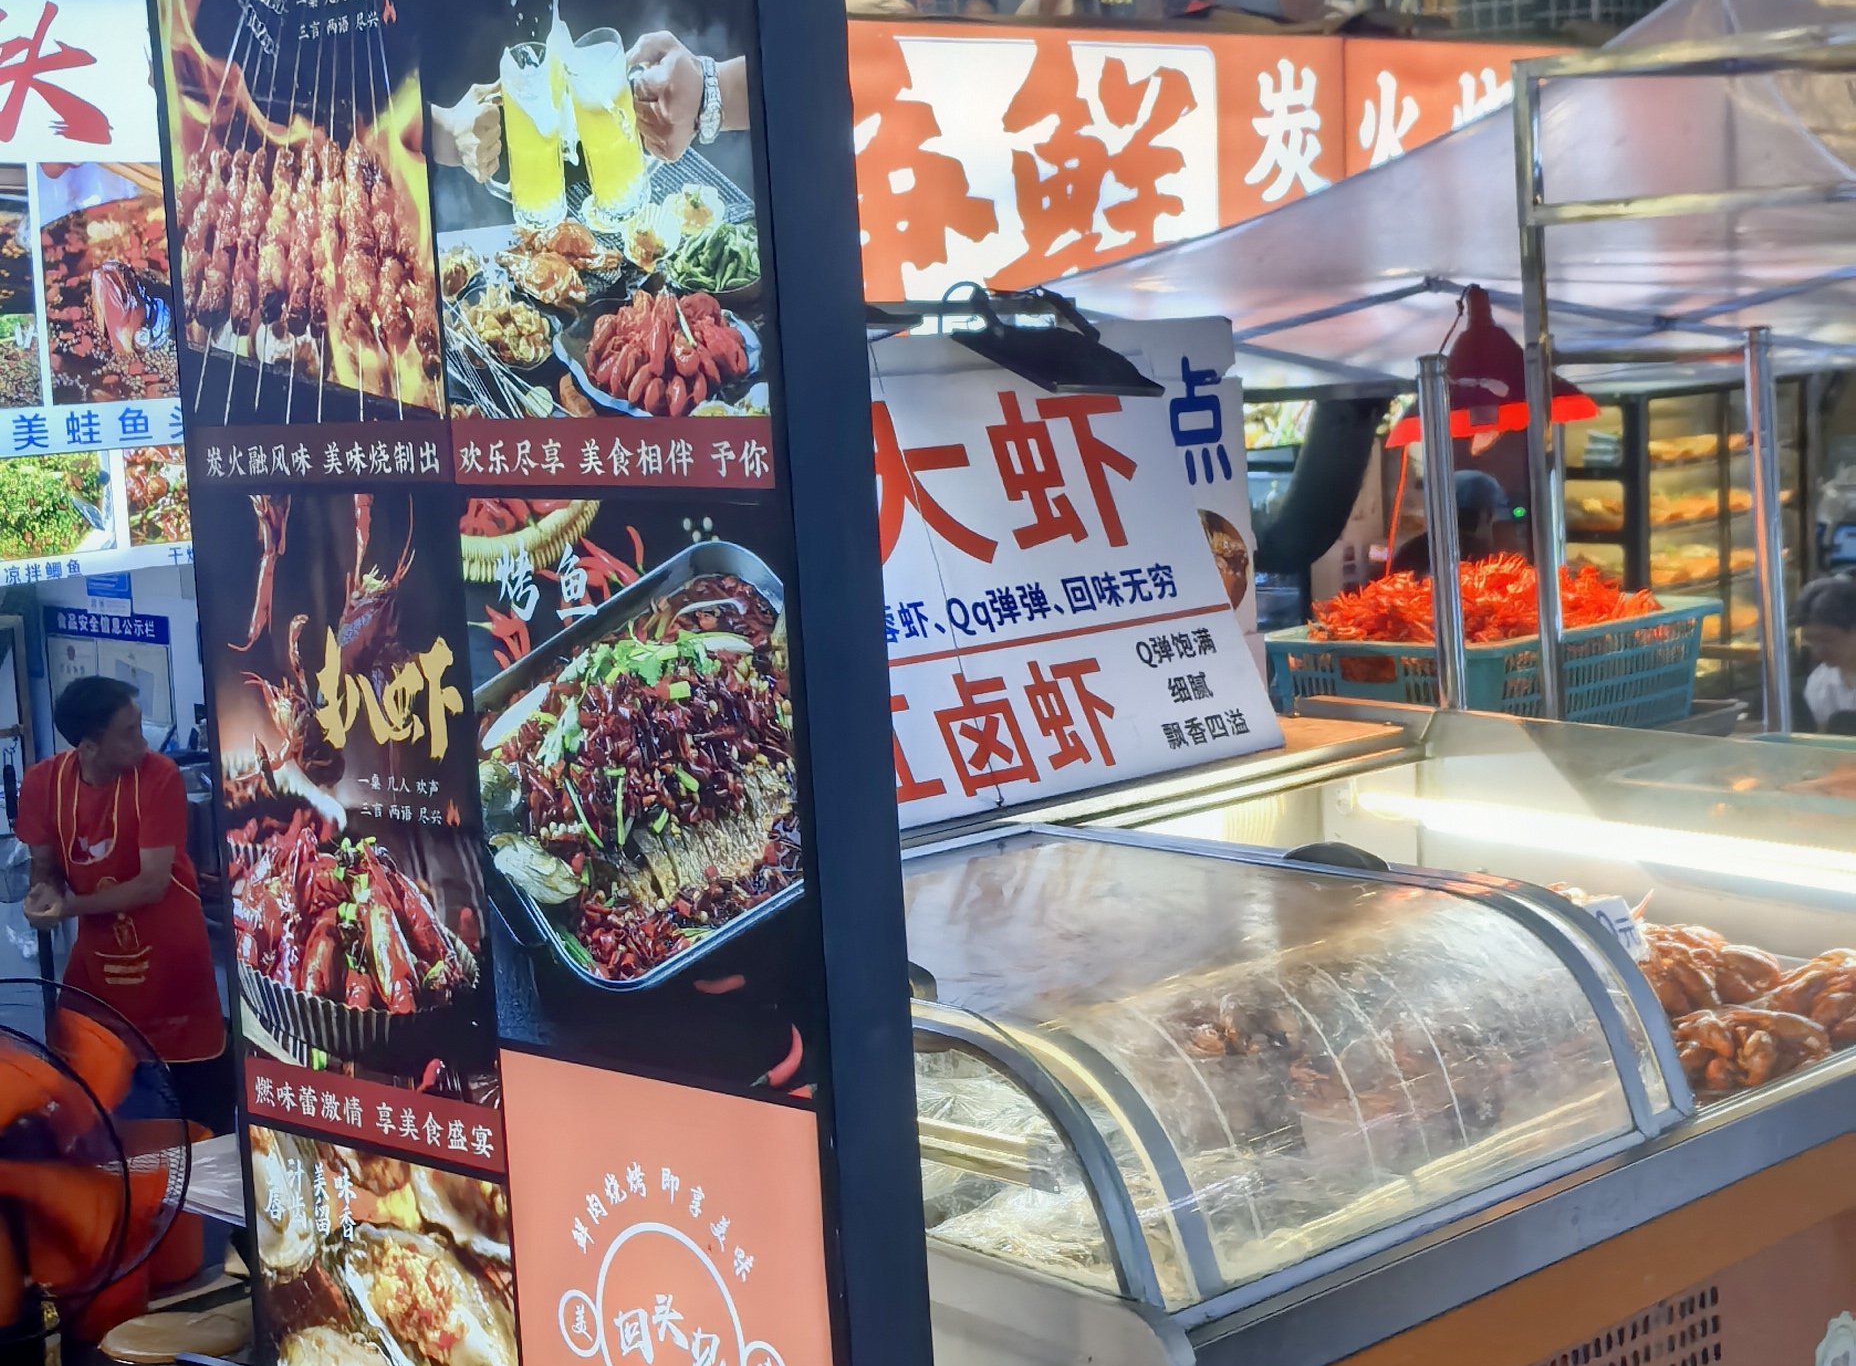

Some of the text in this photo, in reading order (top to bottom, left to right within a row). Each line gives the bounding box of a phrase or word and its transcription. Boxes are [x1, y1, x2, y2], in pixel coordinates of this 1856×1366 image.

[355, 11, 380, 32] 尽兴
[1244, 59, 1513, 203] 炭火
[1169, 356, 1233, 485] 点
[206, 440, 440, 477] 炭火融风味 美味烧制出
[458, 436, 770, 479] 欢乐尽享 美食相伴 予你
[495, 540, 598, 622] 烤鱼
[57, 611, 156, 637] 食品安全信息公示栏
[1136, 627, 1218, 669] Q弹饱满
[316, 625, 464, 764] 扒虾
[1168, 671, 1214, 704] 细腻
[1161, 708, 1251, 750] 飘香四溢
[358, 773, 440, 797] 一桌 几人 欢声
[255, 1075, 495, 1160] 燃味蕾激情 享美食盛宴
[264, 1153, 357, 1206] 汁美味
